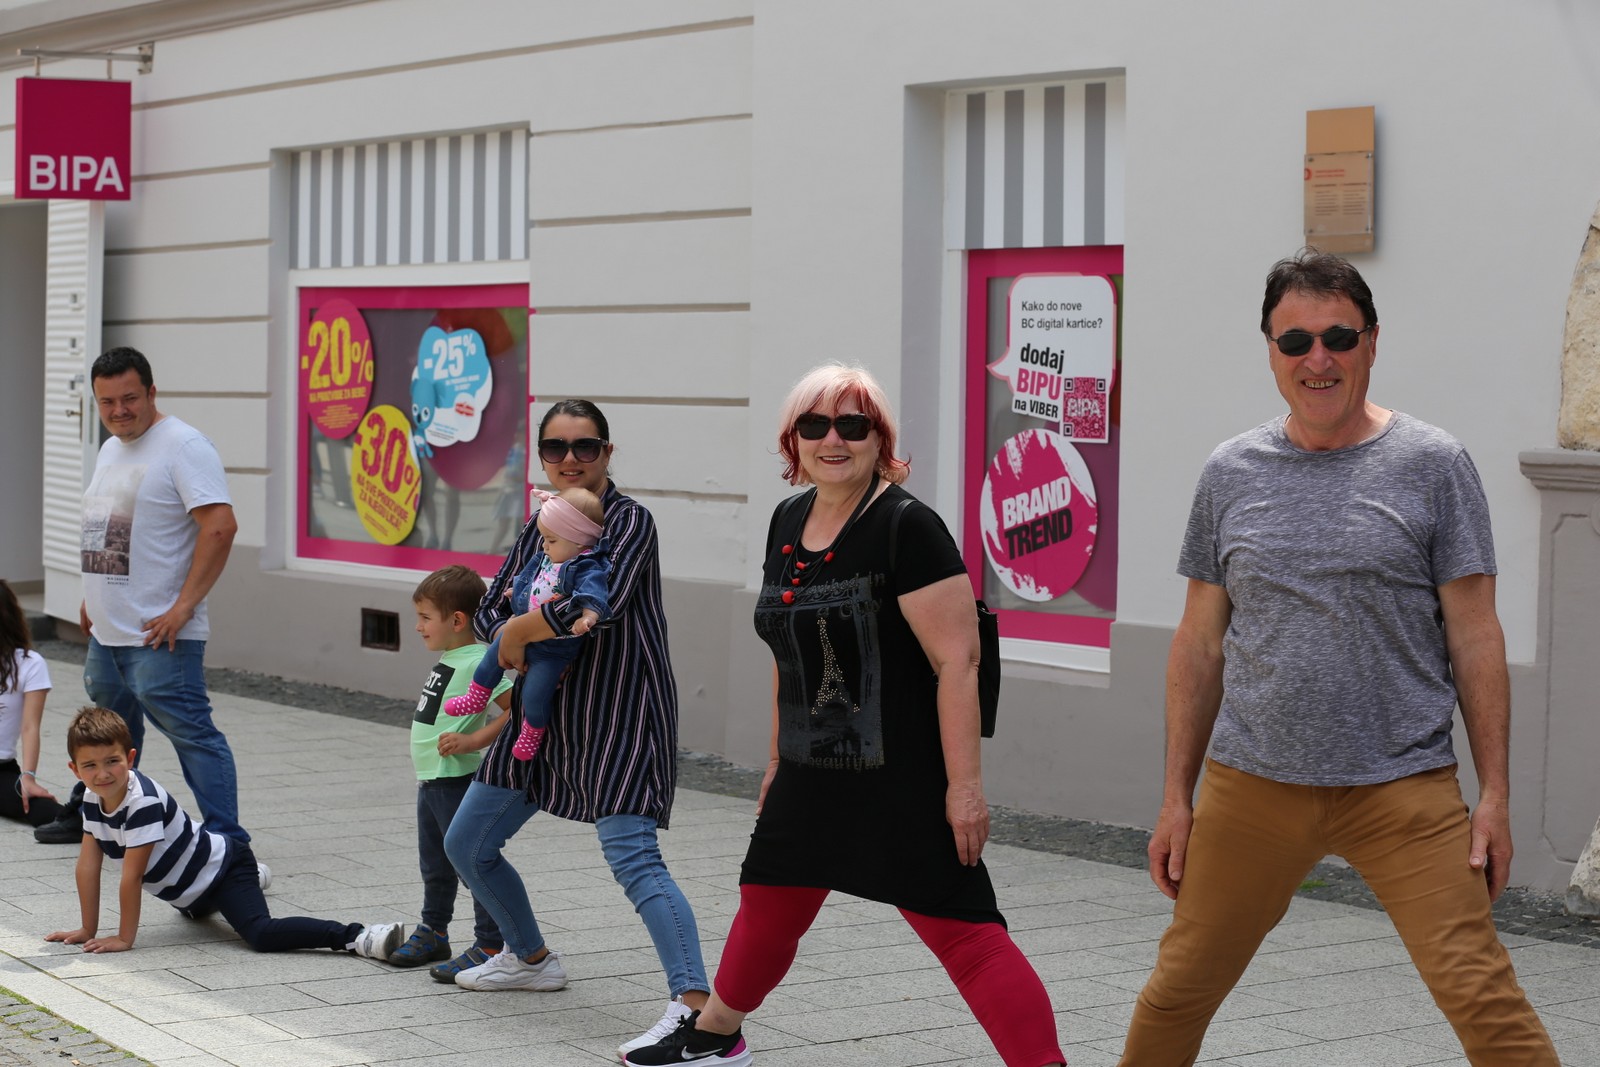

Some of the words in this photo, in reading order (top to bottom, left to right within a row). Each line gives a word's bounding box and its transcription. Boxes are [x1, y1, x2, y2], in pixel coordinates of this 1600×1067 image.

[29, 154, 125, 192] BIPA
[1021, 301, 1044, 311] Kako
[1046, 301, 1058, 311] do
[1060, 303, 1082, 311] nove
[1021, 318, 1035, 329] BC
[1037, 317, 1064, 331] digital
[1066, 317, 1103, 329] kartice?
[301, 317, 374, 389] -20%
[424, 333, 477, 381] -25%
[1020, 343, 1065, 374] dodaj
[1016, 367, 1062, 400] BIPU
[1014, 399, 1027, 411] na
[1029, 399, 1059, 418] VIBER
[1067, 398, 1101, 417] BIPA
[354, 412, 422, 513] -30%
[1002, 476, 1072, 530] BRAND
[1004, 508, 1073, 560] TREND
